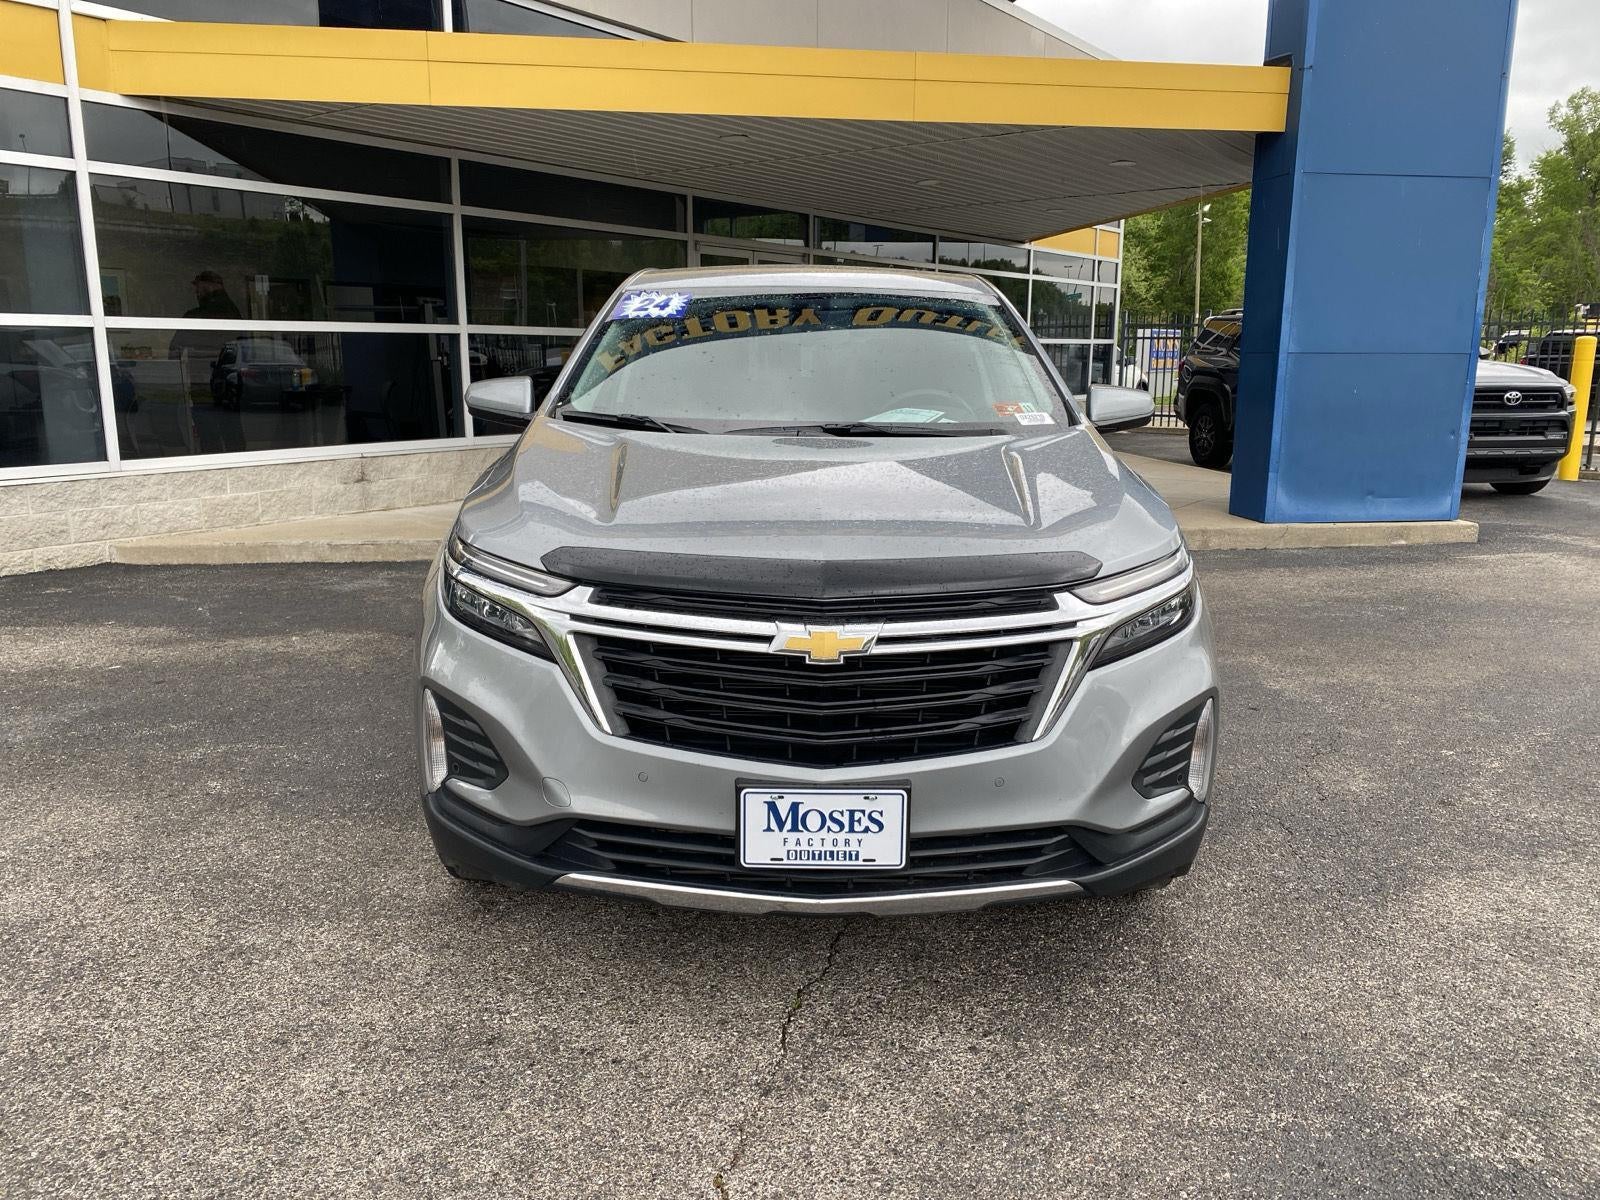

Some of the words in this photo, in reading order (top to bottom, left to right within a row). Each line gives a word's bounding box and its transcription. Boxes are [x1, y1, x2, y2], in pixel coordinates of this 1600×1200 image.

[632, 297, 674, 312] 24
[762, 800, 885, 834] MOSES
[783, 837, 864, 847] FACTORY
[787, 849, 860, 861] OUTLET
